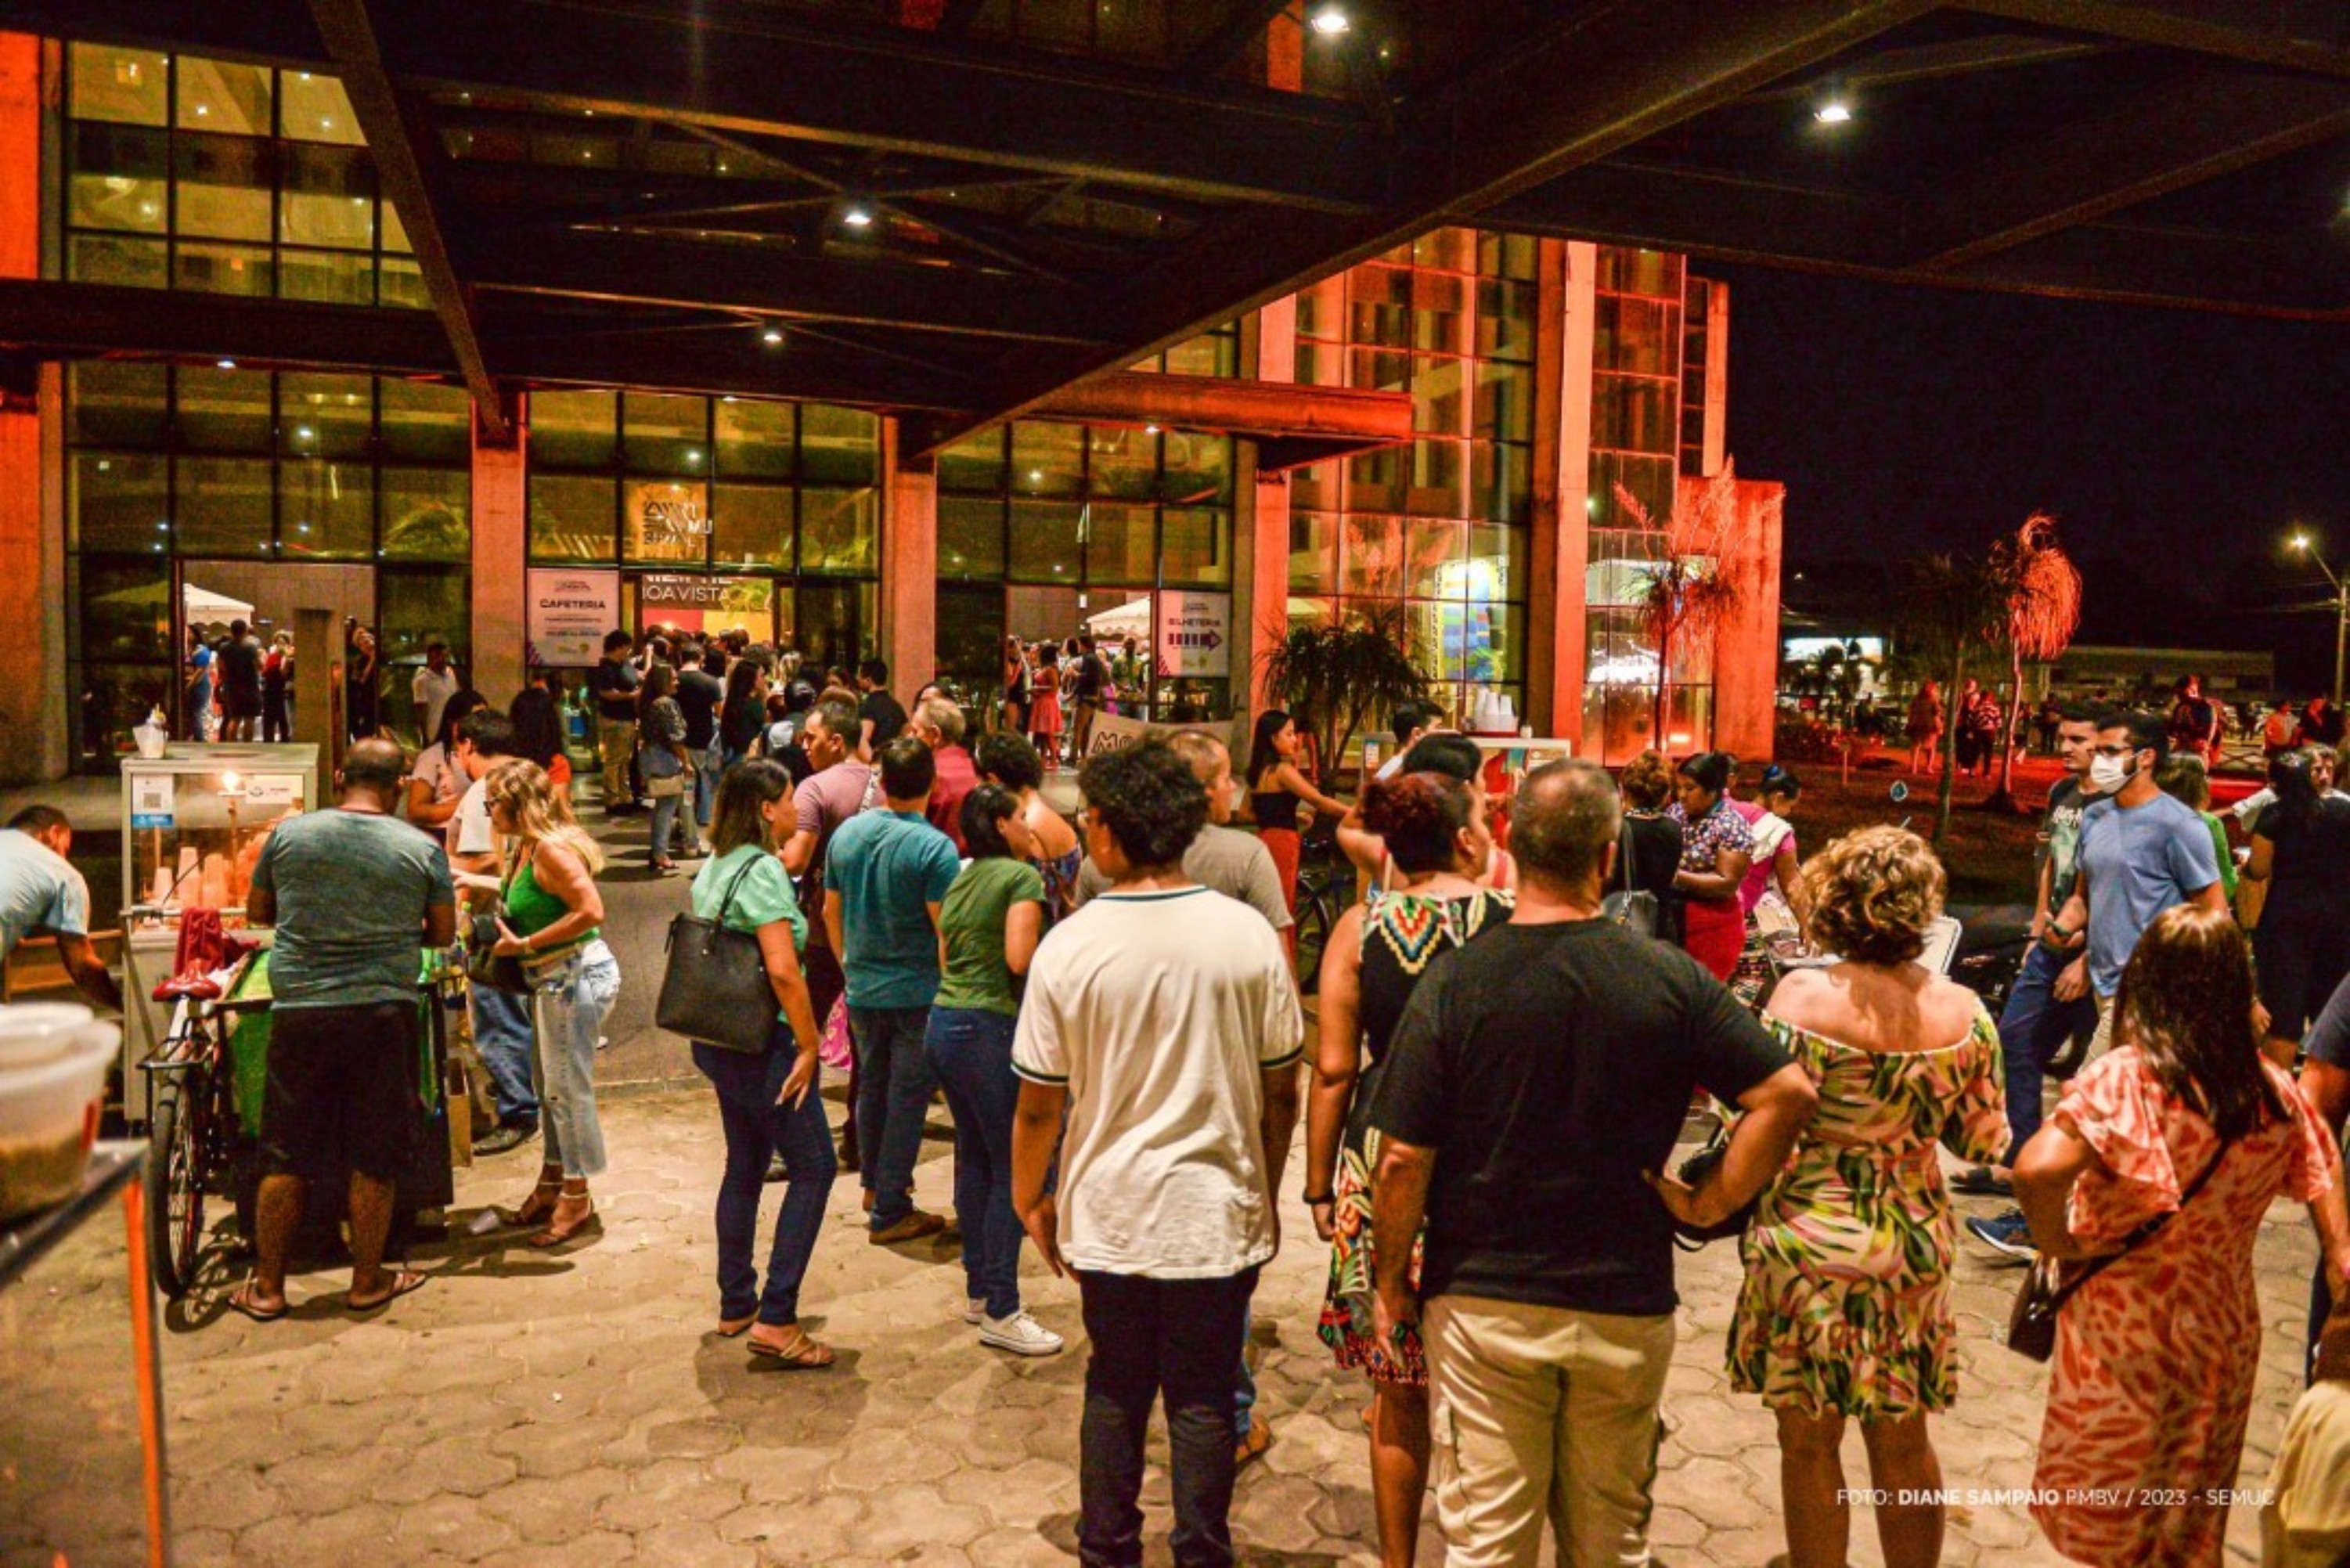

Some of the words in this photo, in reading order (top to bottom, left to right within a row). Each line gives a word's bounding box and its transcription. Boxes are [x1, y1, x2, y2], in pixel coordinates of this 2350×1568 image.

[642, 584, 676, 601] OA
[540, 598, 606, 610] CAFETERIA
[1169, 618, 1220, 627] BILHETERIA
